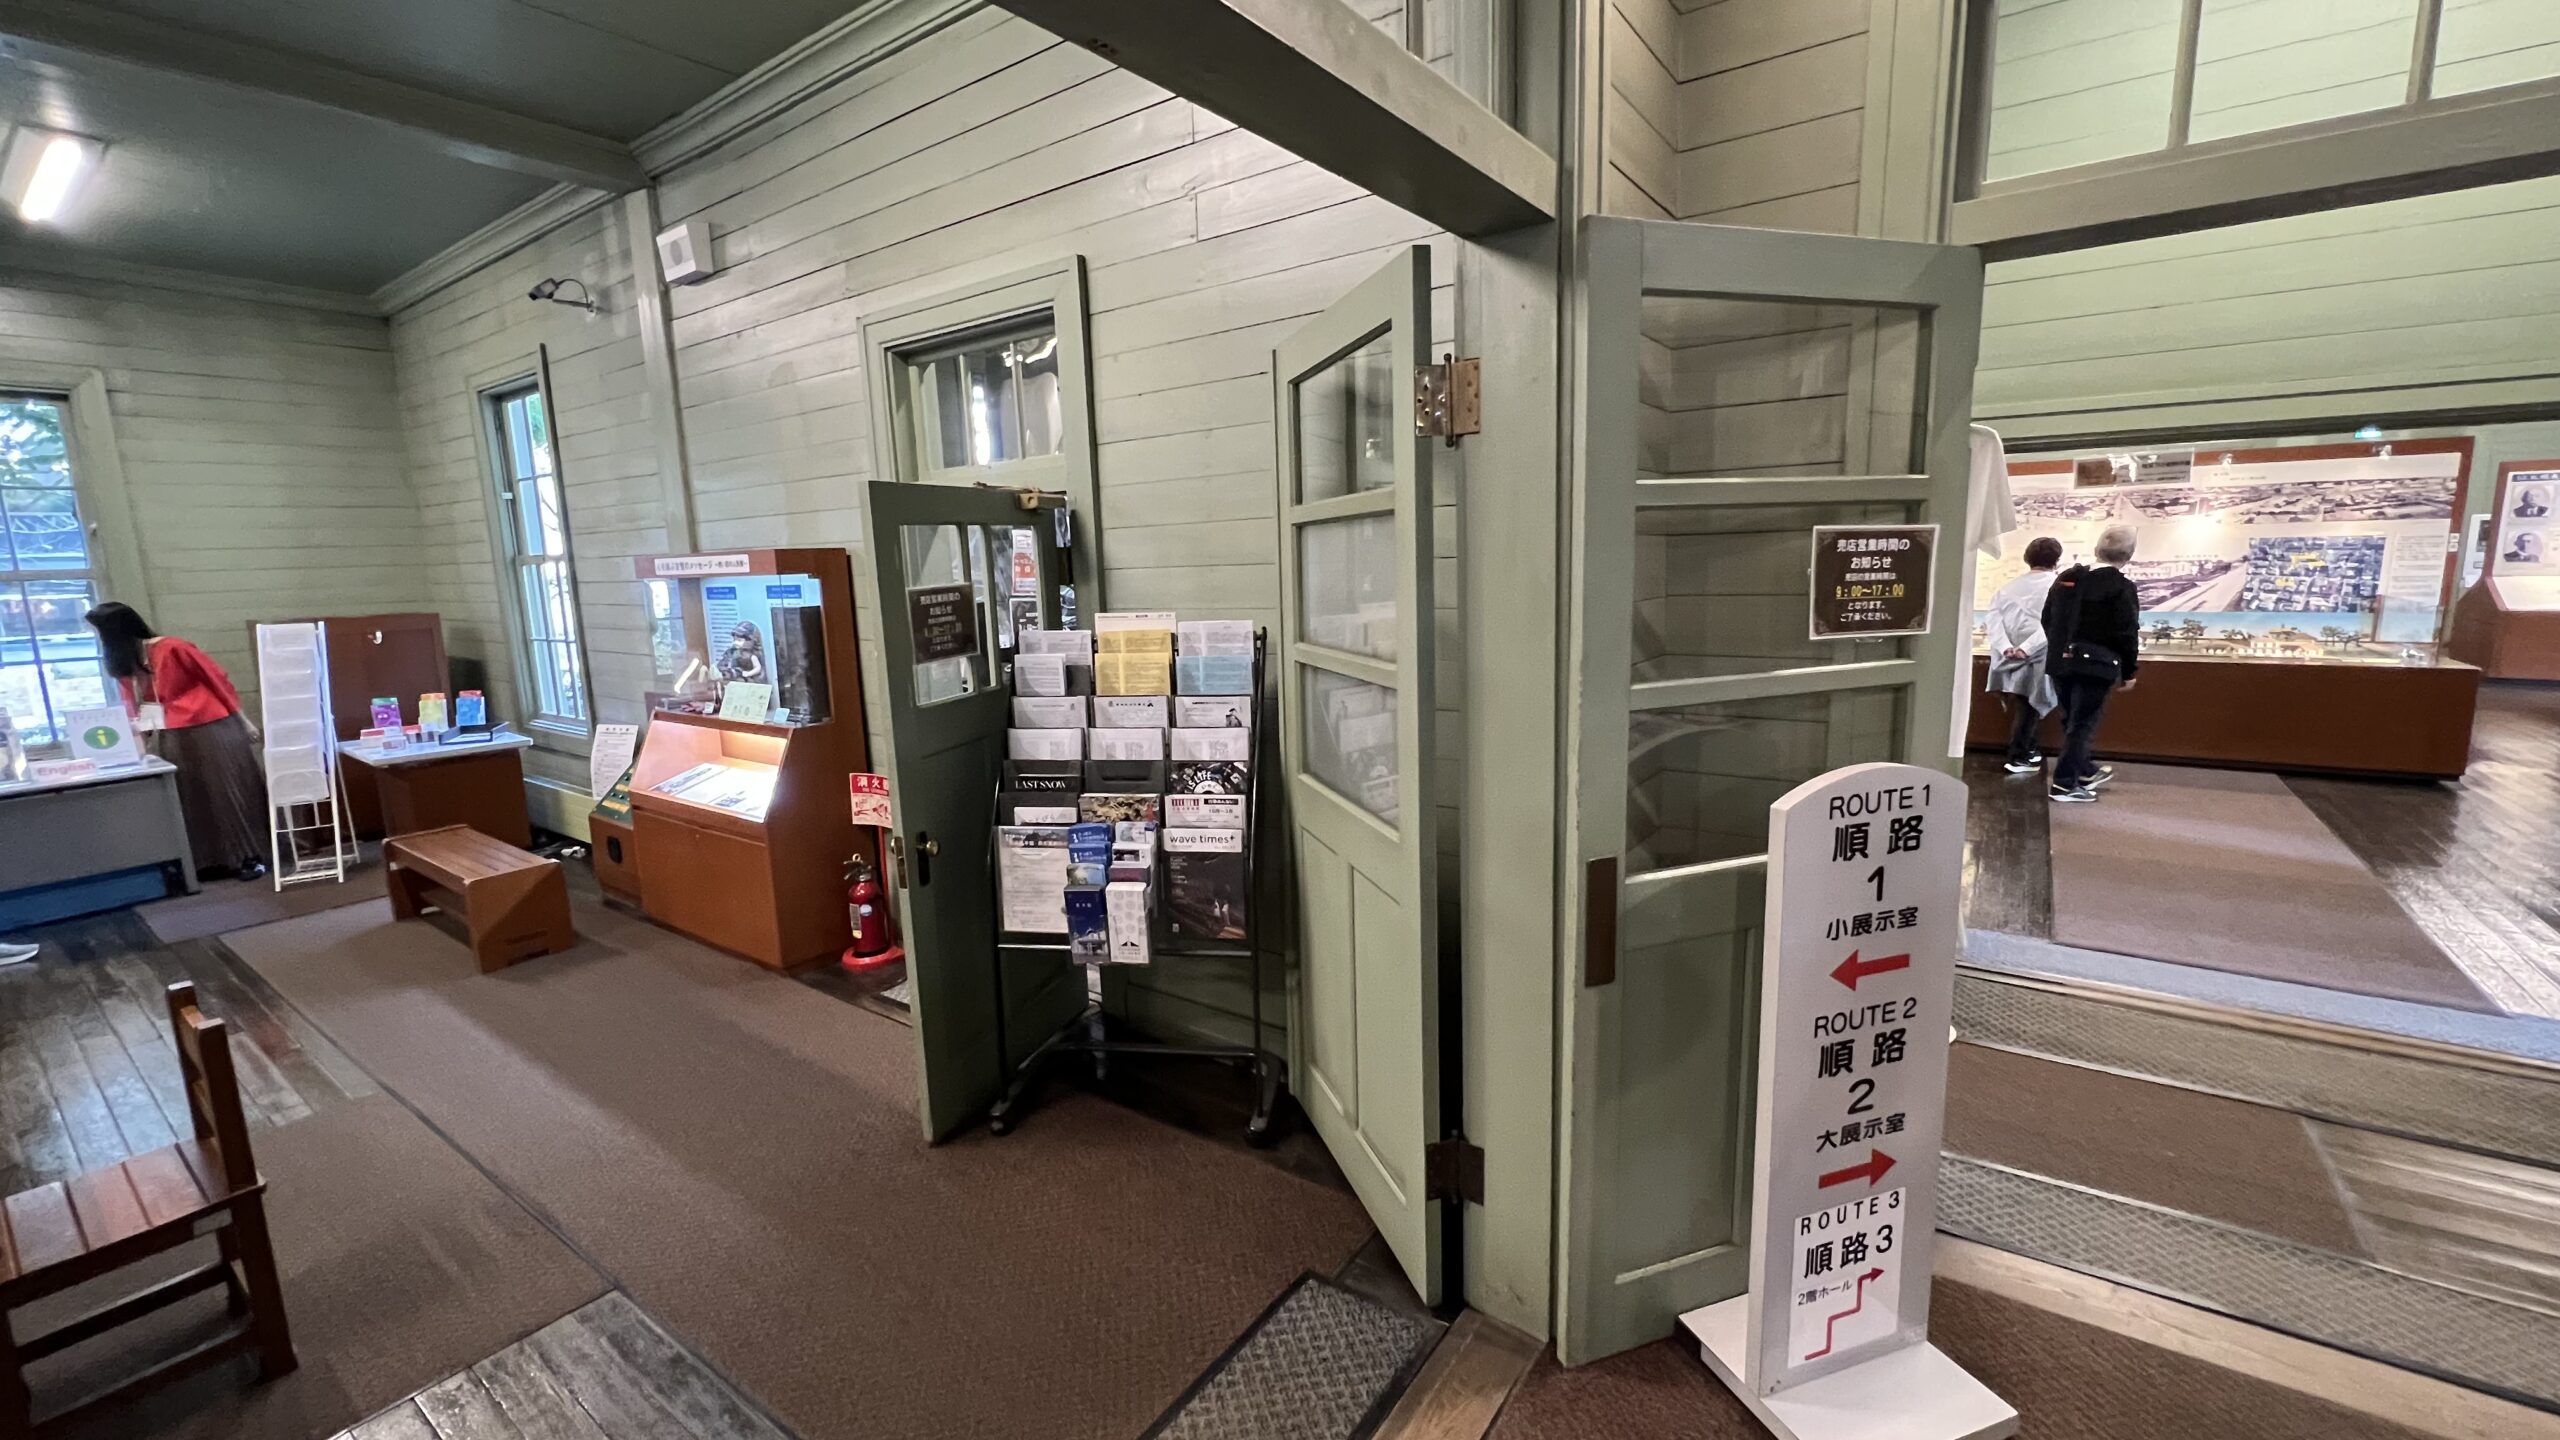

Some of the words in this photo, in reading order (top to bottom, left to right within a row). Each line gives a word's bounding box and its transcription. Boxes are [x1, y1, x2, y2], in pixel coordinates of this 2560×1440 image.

[1836, 538, 1911, 552] 売店営業時間の
[1850, 556, 1893, 569] お知らせ
[37, 762, 96, 776] English
[1015, 781, 1038, 789] LAST
[1039, 781, 1066, 789] SNOW
[1830, 786, 1914, 820] ROUTE
[1922, 784, 1931, 807] 1
[1170, 836, 1196, 844] wave
[1832, 815, 1924, 862] 順路
[1867, 866, 1885, 902] 1
[1826, 907, 1919, 940] 小展示室
[1814, 1000, 1896, 1038] ROUTE
[1903, 997, 1917, 1019] 2
[1818, 1028, 1907, 1079] 順路
[1847, 1078, 1875, 1114] 2
[1816, 1113, 1906, 1153] 大展示室
[1801, 1196, 1879, 1236] ROUTE
[1888, 1190, 1900, 1209] 3
[1797, 1279, 1853, 1306] 2階ホール
